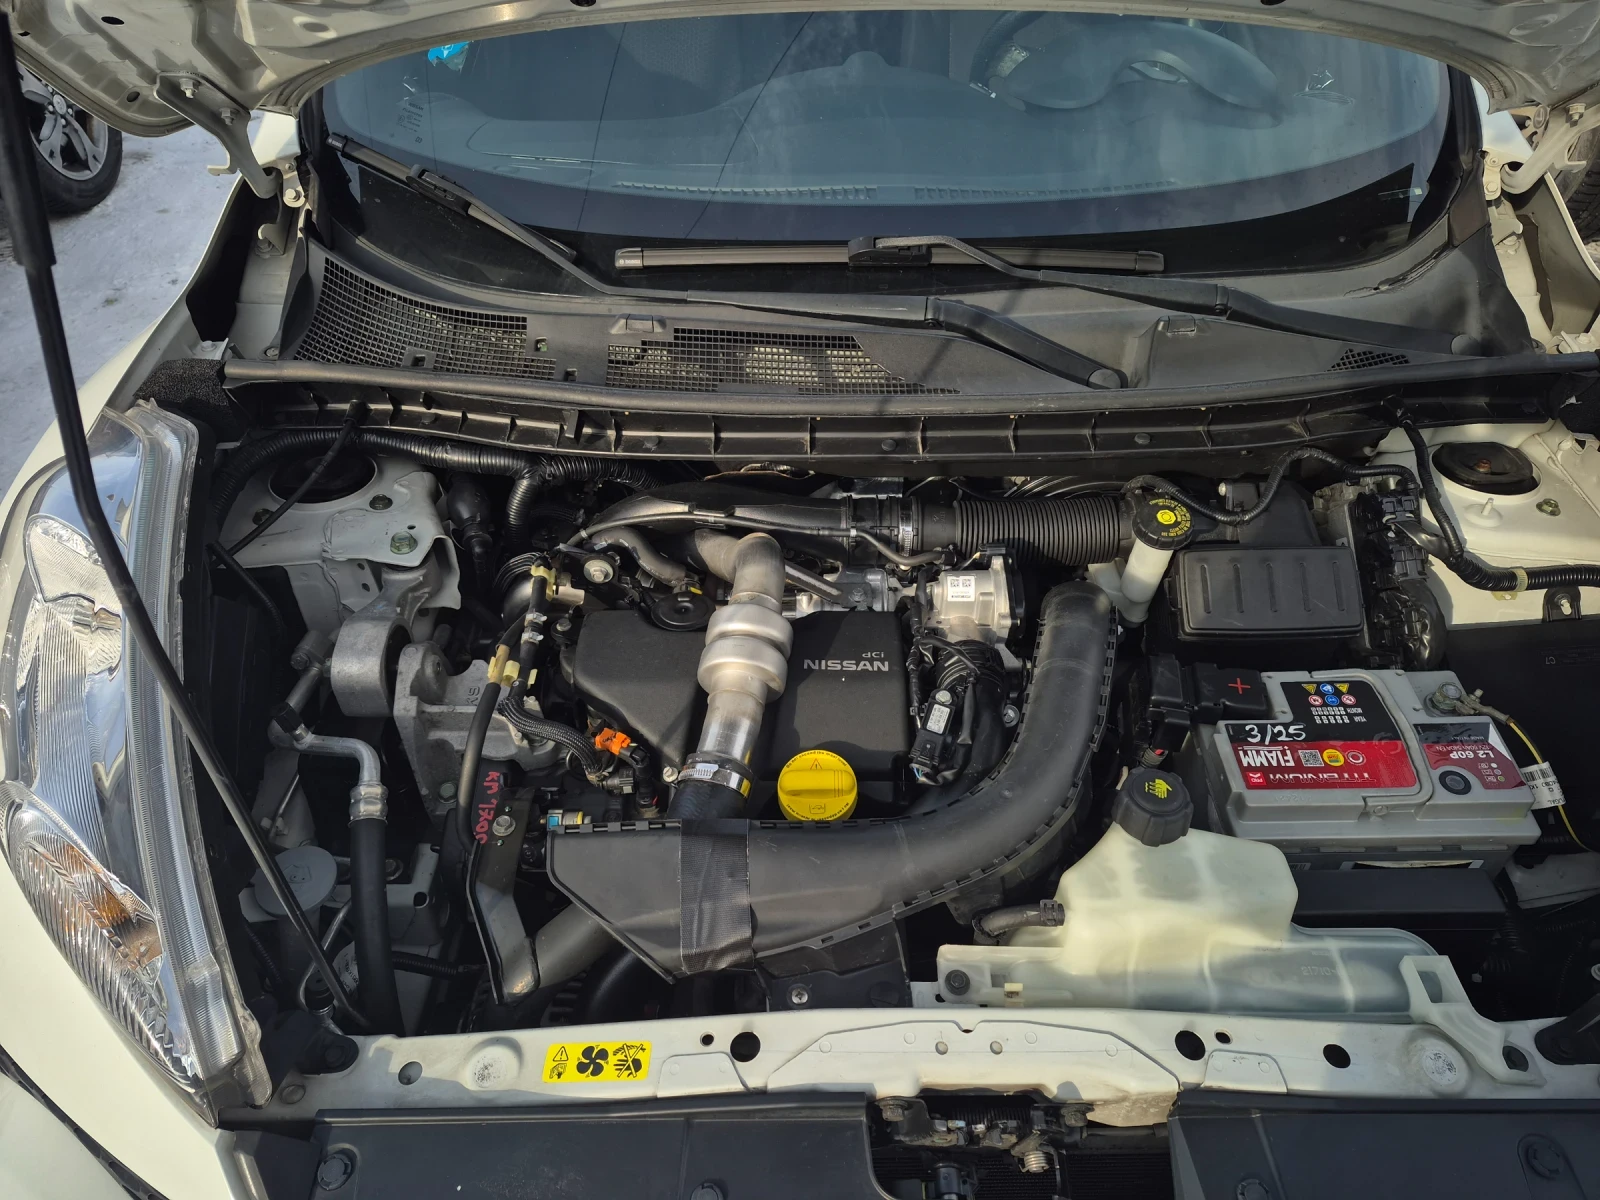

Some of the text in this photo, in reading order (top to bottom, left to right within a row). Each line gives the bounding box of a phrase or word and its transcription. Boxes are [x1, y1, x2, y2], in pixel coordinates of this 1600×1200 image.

[804, 659, 888, 672] NISSAN
[1245, 724, 1306, 745] 3/25
[1238, 750, 1295, 766] FIAMM
[1269, 773, 1376, 784] TITANIUM
